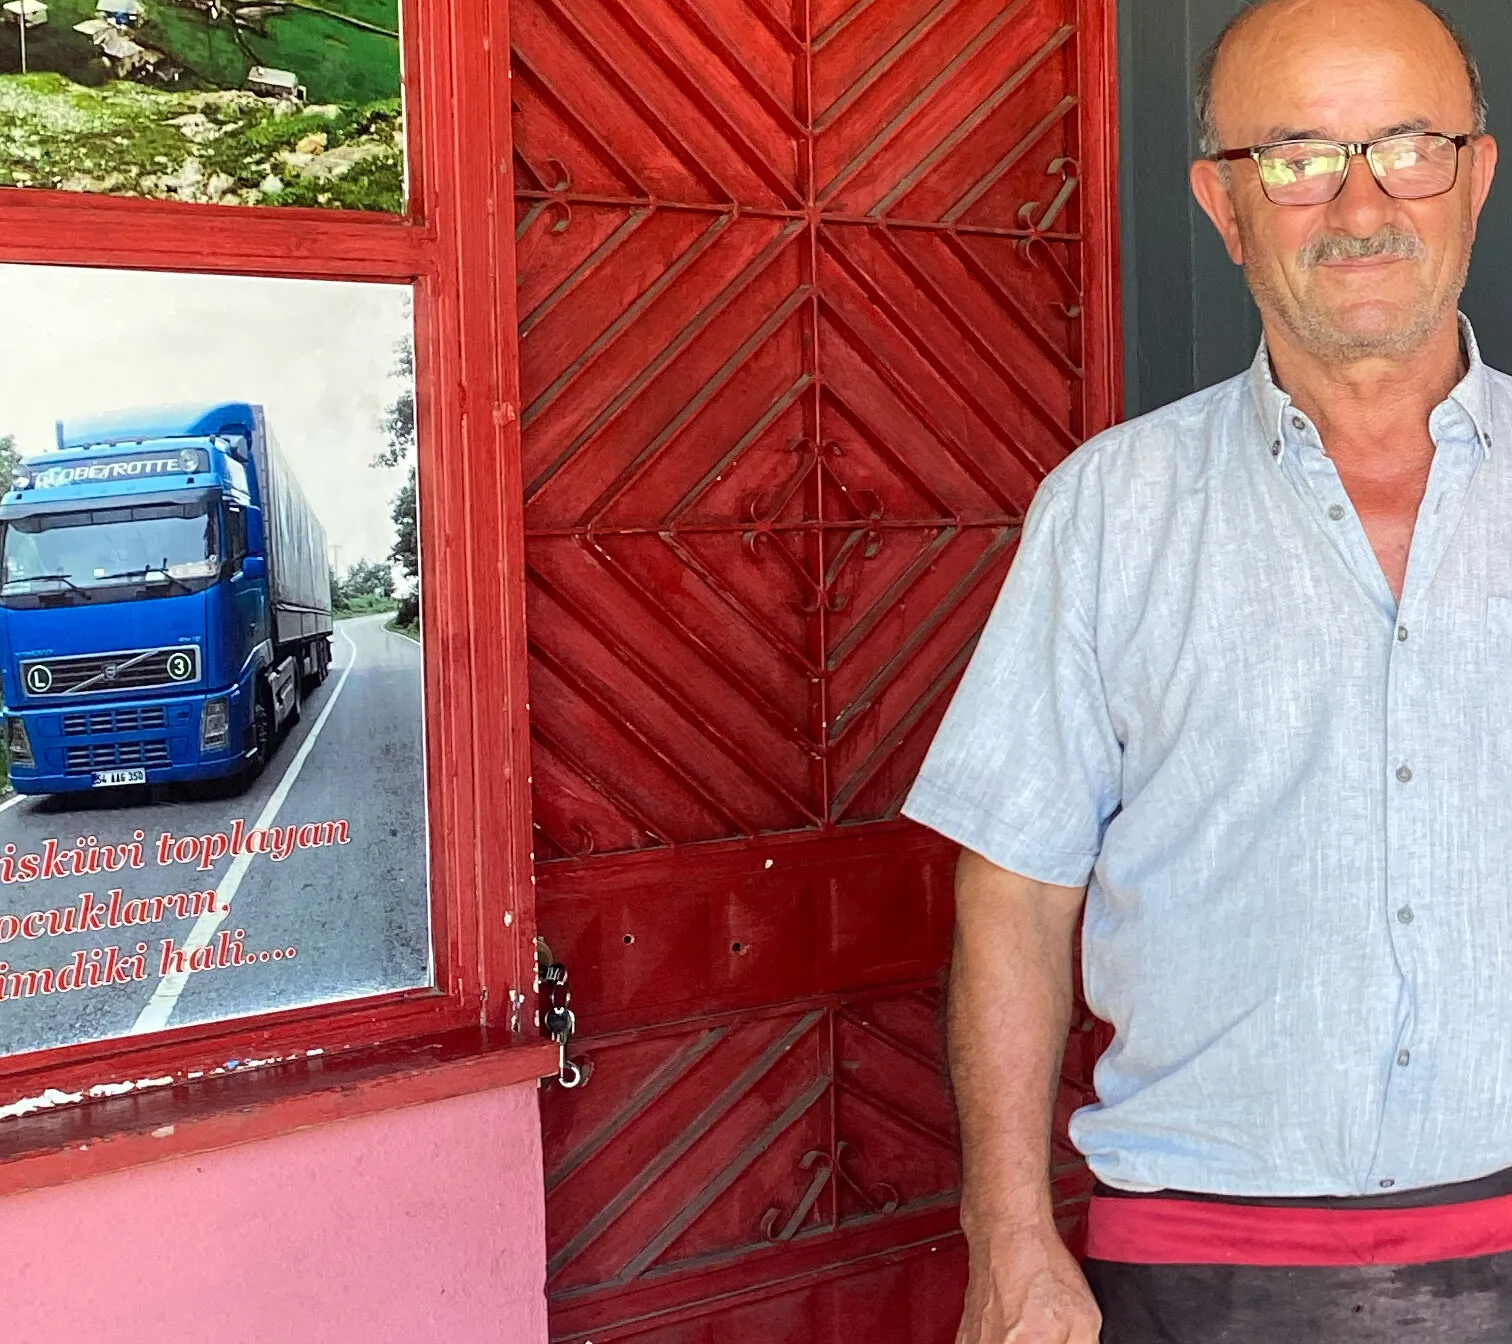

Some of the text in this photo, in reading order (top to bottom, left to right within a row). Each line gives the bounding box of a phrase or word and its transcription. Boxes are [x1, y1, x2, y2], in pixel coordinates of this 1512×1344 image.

[174, 658, 185, 675] 3
[34, 671, 46, 688] L
[155, 818, 351, 872] toplayan
